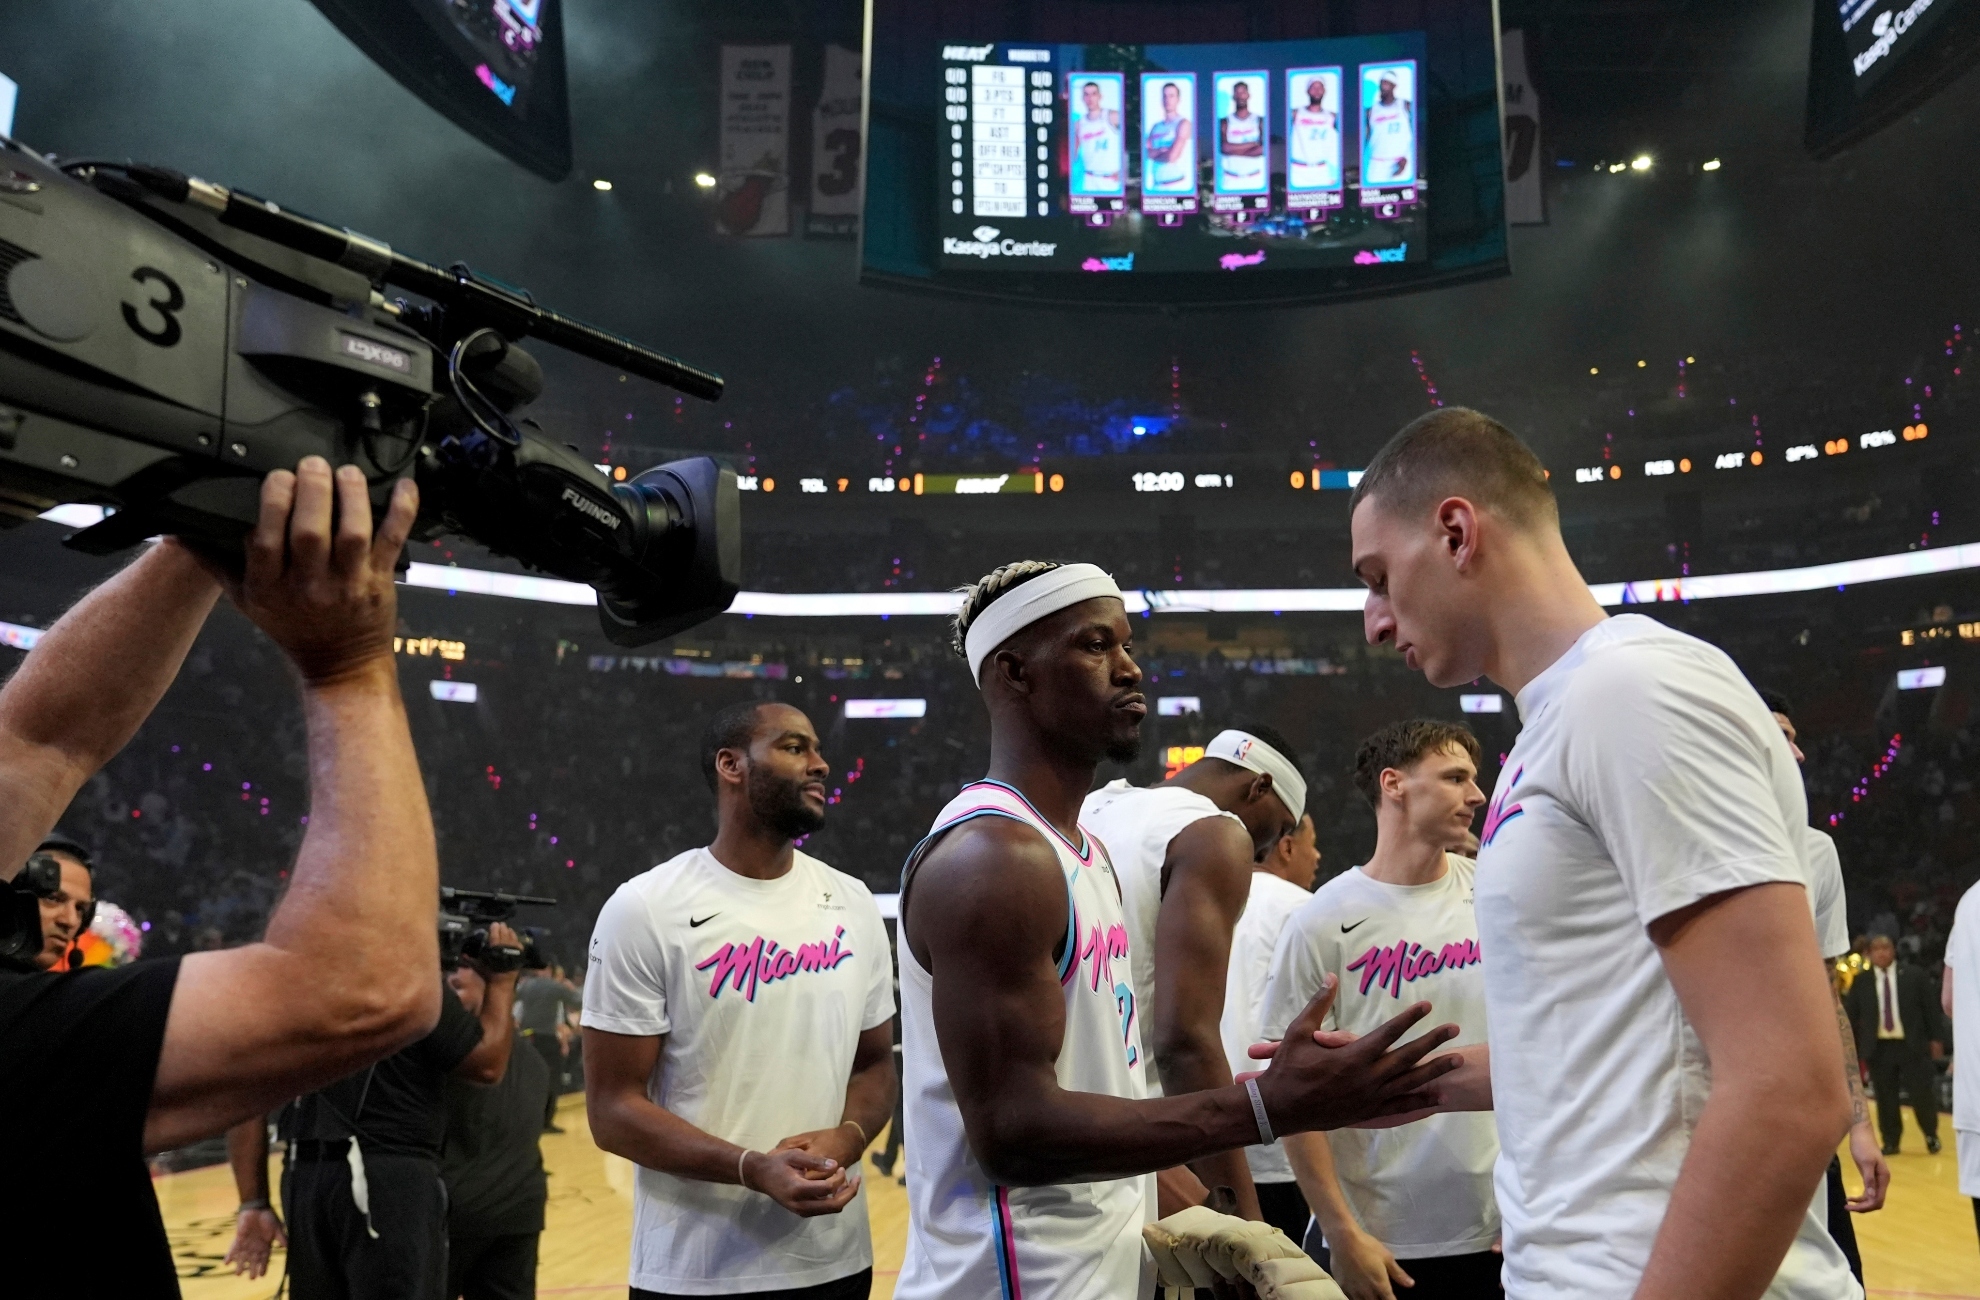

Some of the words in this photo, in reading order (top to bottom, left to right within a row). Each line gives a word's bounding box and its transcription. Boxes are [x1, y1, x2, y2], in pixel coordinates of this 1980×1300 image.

[817, 128, 861, 197] 3
[1382, 203, 1393, 216] C
[943, 237, 1001, 259] Kaseya
[1001, 238, 1057, 256] Center
[121, 265, 185, 348] 3
[737, 475, 758, 491] LK
[762, 477, 775, 492] 0
[837, 477, 849, 492] 7
[899, 477, 911, 492] 0
[1049, 473, 1064, 492] 0
[1132, 471, 1185, 491] 12:00
[1224, 473, 1233, 488] 1
[1290, 471, 1305, 489] 0
[1575, 466, 1604, 483] BLK
[1609, 465, 1622, 480] 0
[1644, 459, 1675, 476] REB
[1679, 458, 1692, 473] 0
[1714, 451, 1745, 469] AST
[1750, 450, 1763, 466] 0
[561, 487, 621, 530] FUJINON
[695, 925, 854, 1004] Miami
